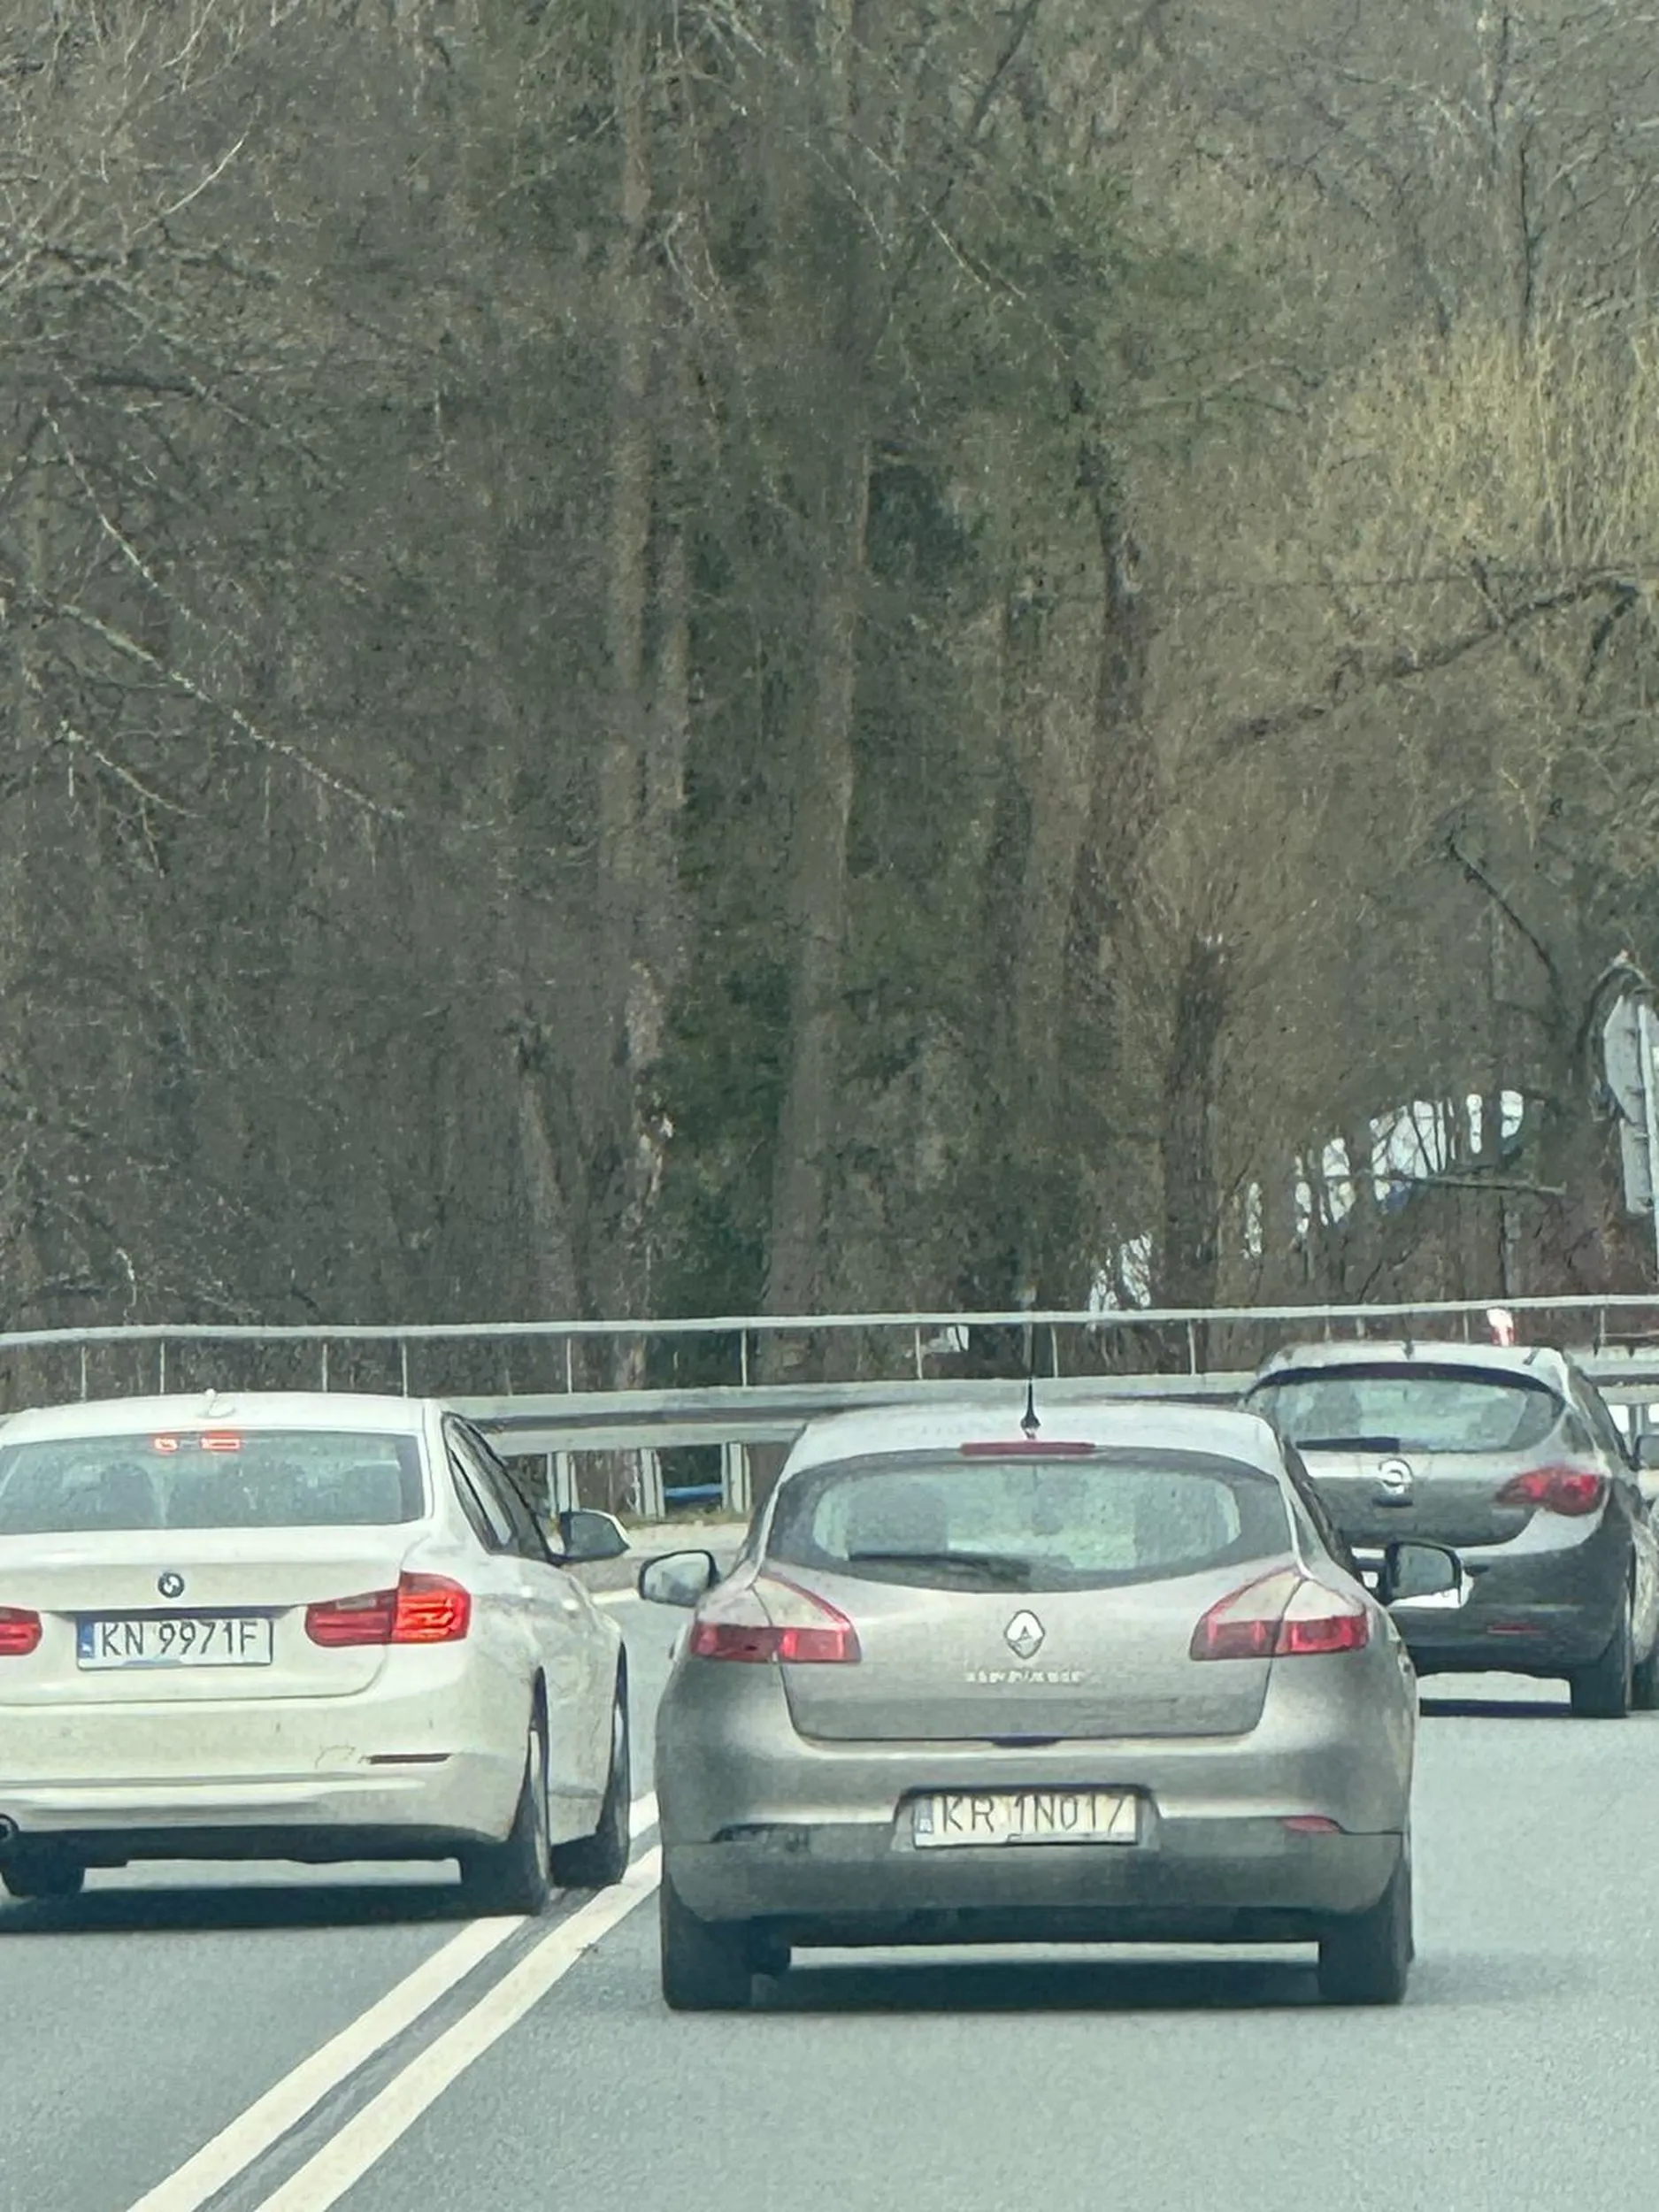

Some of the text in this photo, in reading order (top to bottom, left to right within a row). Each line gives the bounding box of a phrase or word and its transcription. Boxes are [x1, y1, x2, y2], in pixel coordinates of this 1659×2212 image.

[102, 1620, 257, 1656] KN 9971F
[941, 1794, 995, 1832] KR
